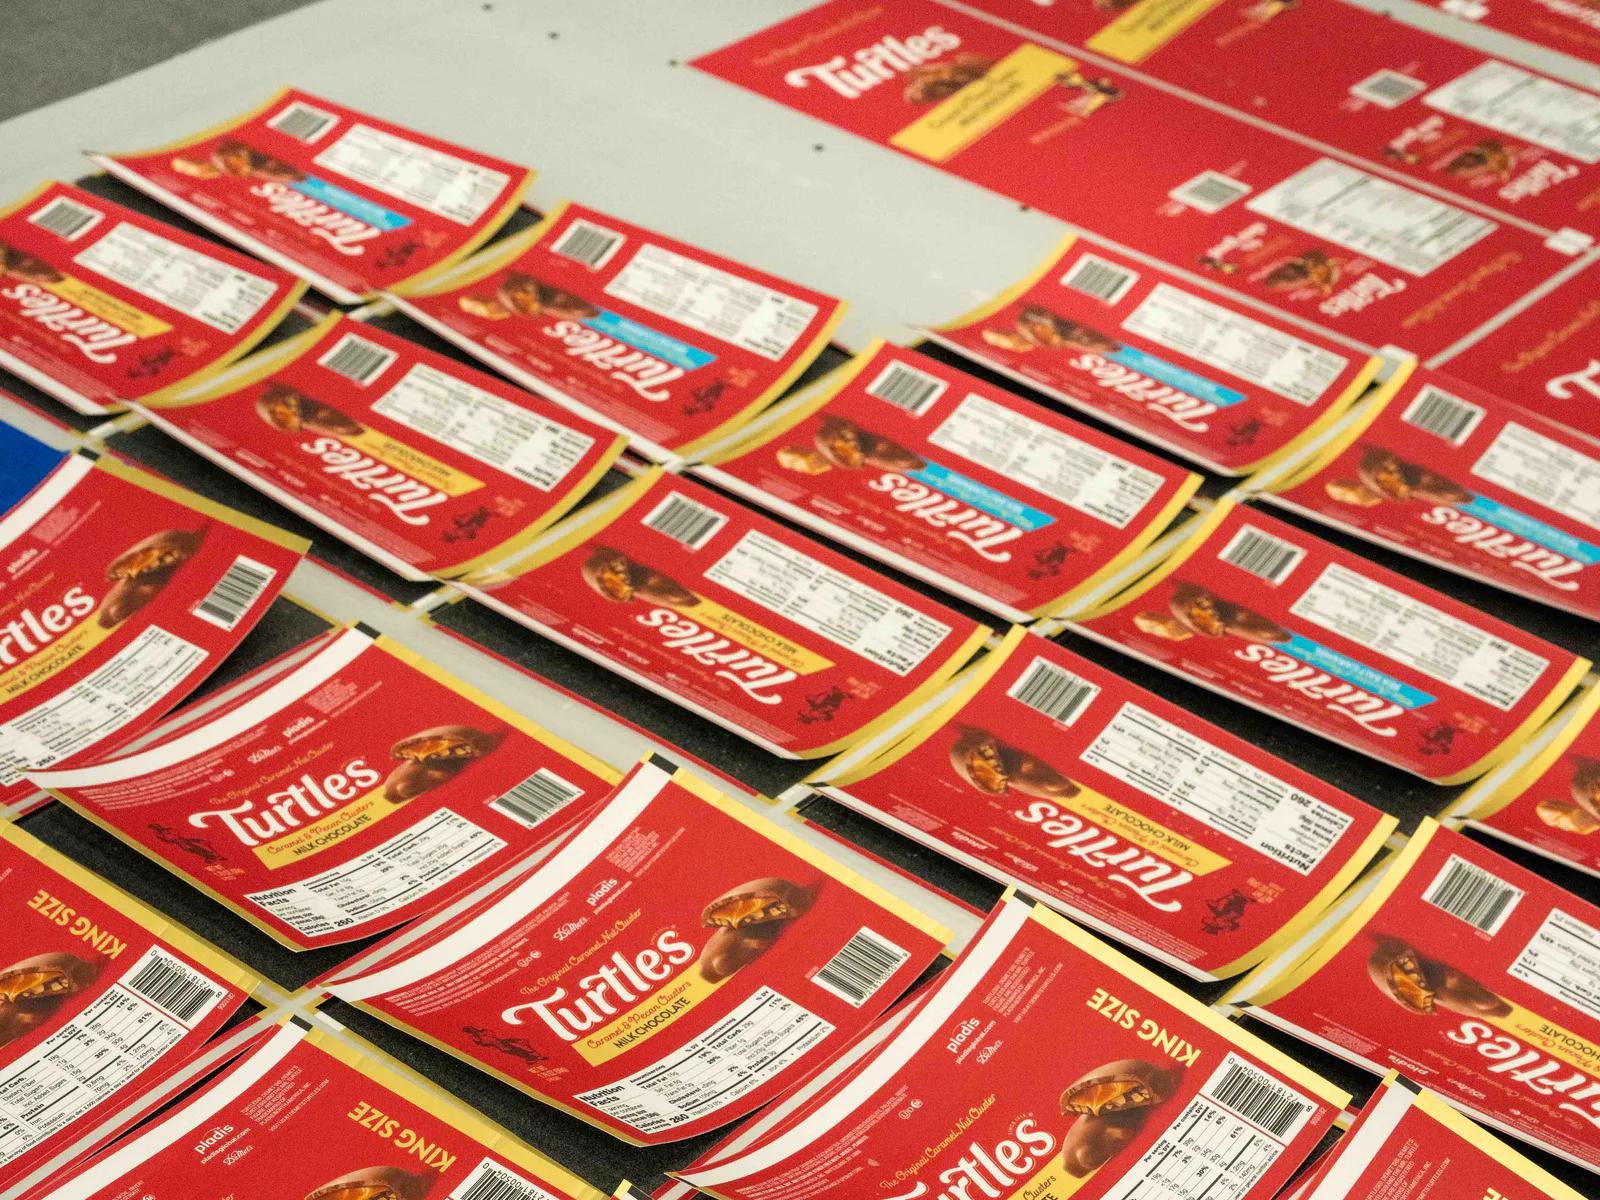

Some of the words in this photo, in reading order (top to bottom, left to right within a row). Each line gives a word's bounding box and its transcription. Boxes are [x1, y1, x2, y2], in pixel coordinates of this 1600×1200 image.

[784, 26, 961, 98] Turtles
[250, 182, 381, 256] Turtles
[1, 283, 137, 364] Turtles
[542, 319, 686, 402] Turtles
[1069, 353, 1219, 432] Turtles
[301, 436, 449, 526] Turtles
[868, 472, 1023, 562] Turtles
[1421, 506, 1584, 591] Turtles
[0, 586, 95, 669] rtles
[637, 609, 797, 704] Turtles
[1234, 644, 1404, 736] Turtles
[188, 760, 381, 846] Turtles
[1103, 803, 1166, 839] CHOCOLATE
[293, 841, 318, 856] MILK
[315, 814, 372, 846] CHOCOLATE
[1015, 802, 1193, 912] Turtles
[1163, 833, 1191, 852] MILK
[1261, 842, 1310, 871] Nutrition
[1285, 844, 1316, 864] Facts
[27, 890, 76, 926] SIZE
[587, 878, 618, 906] pladis
[70, 917, 127, 960] KING
[501, 930, 695, 1041] Turtles
[587, 1028, 624, 1049] Caramel
[623, 1019, 631, 1030] &
[629, 1003, 661, 1023] Pecan
[658, 981, 691, 1006] Clusters
[613, 1031, 637, 1049] MILK
[635, 996, 691, 1034] CHOCOLATE
[1085, 987, 1141, 1030] SIZE
[946, 1017, 980, 1054] pladis
[956, 1020, 996, 1065] pladisglobal.com
[1137, 1018, 1202, 1068] KING
[1388, 1055, 1429, 1075] pladis
[581, 1085, 625, 1102] Nutrition
[589, 1095, 620, 1108] Facts
[194, 1123, 234, 1155] pladis
[346, 1100, 400, 1139] SIZE
[669, 1113, 690, 1126] 260
[201, 1127, 251, 1165] pladisglobal.com
[394, 1130, 457, 1173] KING
